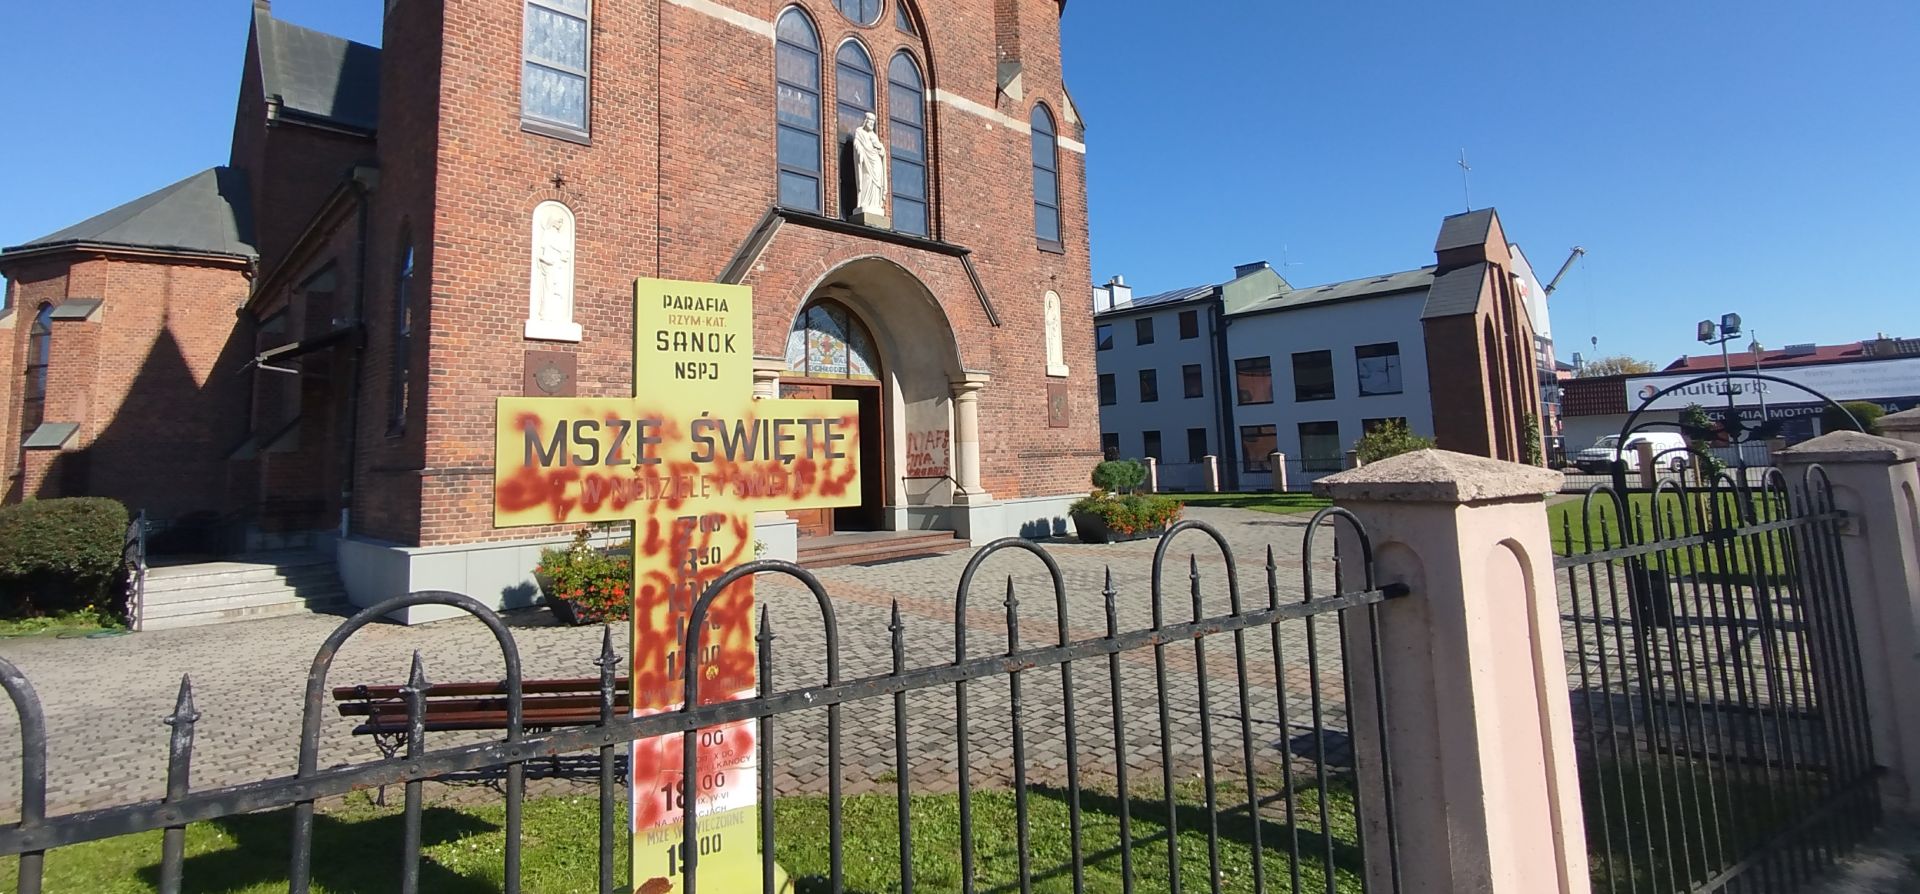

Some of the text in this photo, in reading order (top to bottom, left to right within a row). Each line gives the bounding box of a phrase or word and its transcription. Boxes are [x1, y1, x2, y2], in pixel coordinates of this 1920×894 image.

[663, 294, 729, 312] PARAFIA
[656, 330, 736, 353] SANOK
[675, 361, 719, 380] NSPJ
[524, 411, 845, 467] MSZE ŚWIĘTE
[655, 819, 667, 828] NA
